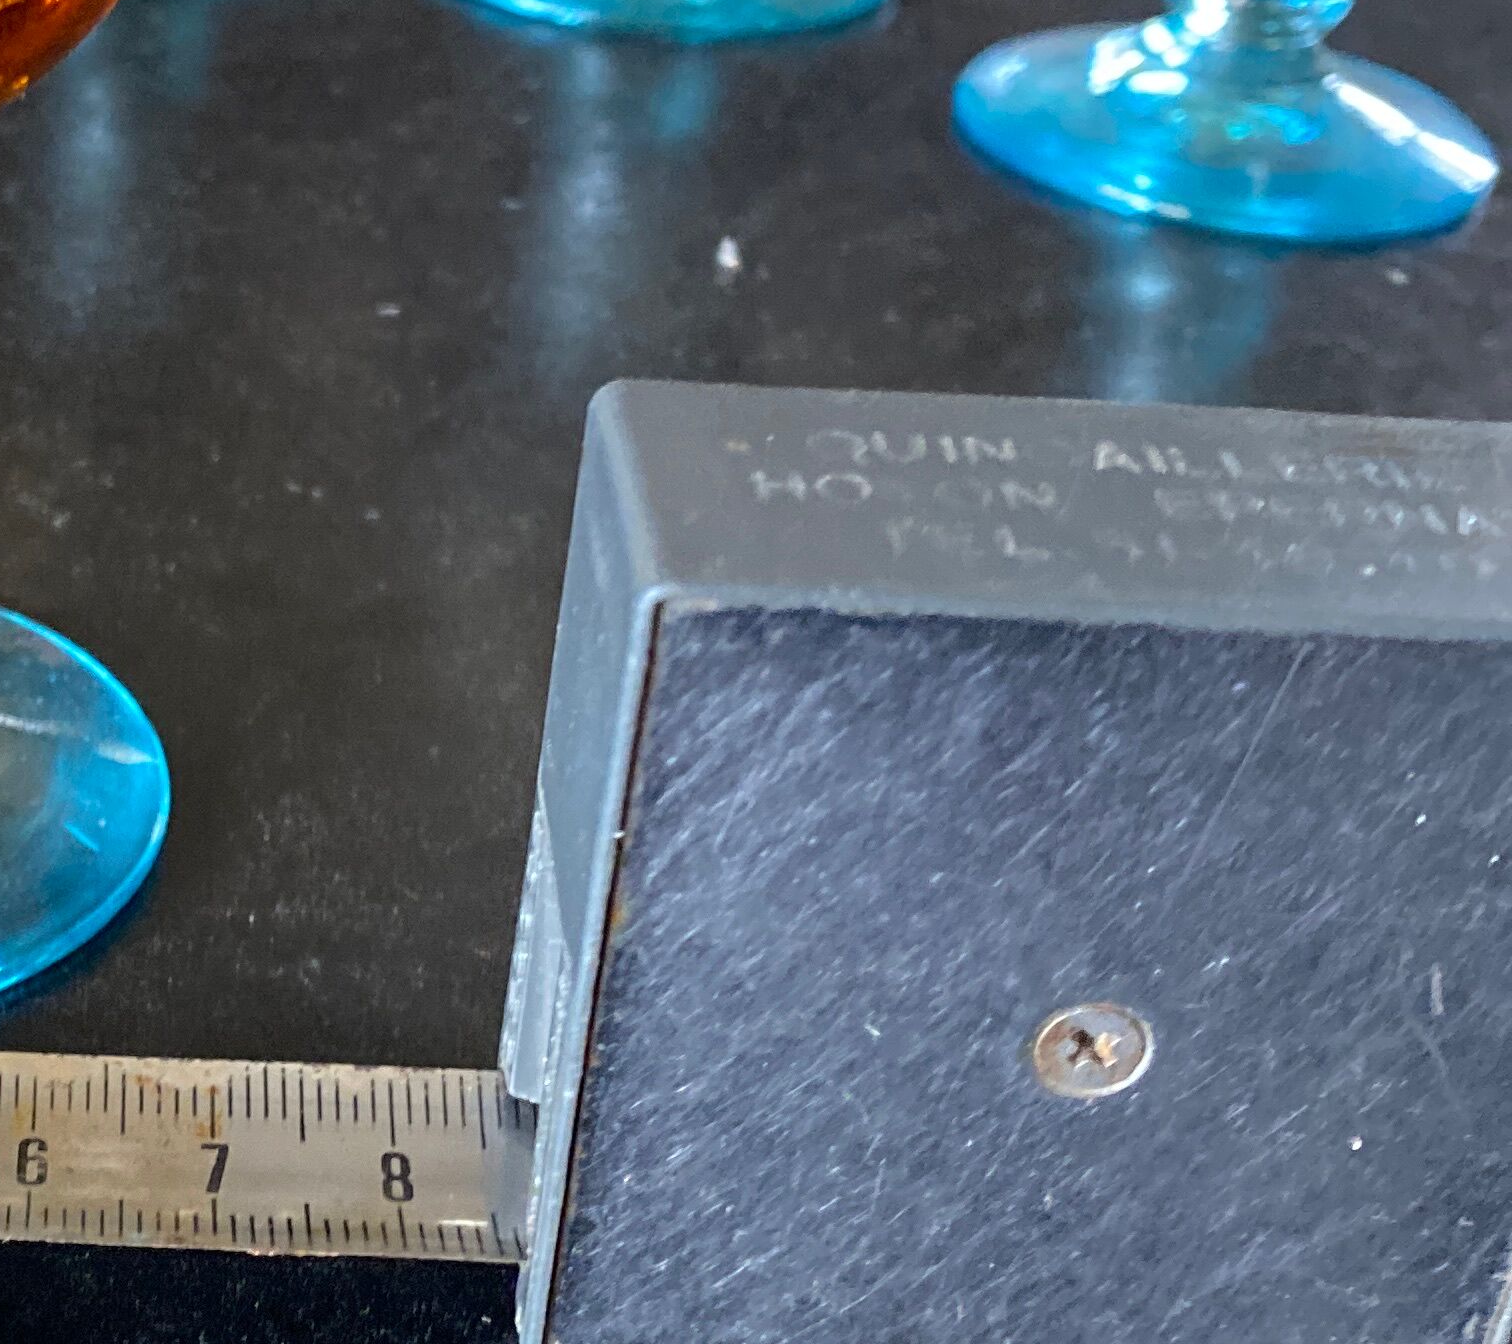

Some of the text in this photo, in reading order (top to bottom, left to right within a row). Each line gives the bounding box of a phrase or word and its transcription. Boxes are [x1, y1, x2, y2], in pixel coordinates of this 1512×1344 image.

[15, 1137, 49, 1187] 6
[199, 1142, 232, 1194] 7
[380, 1151, 415, 1203] 8
